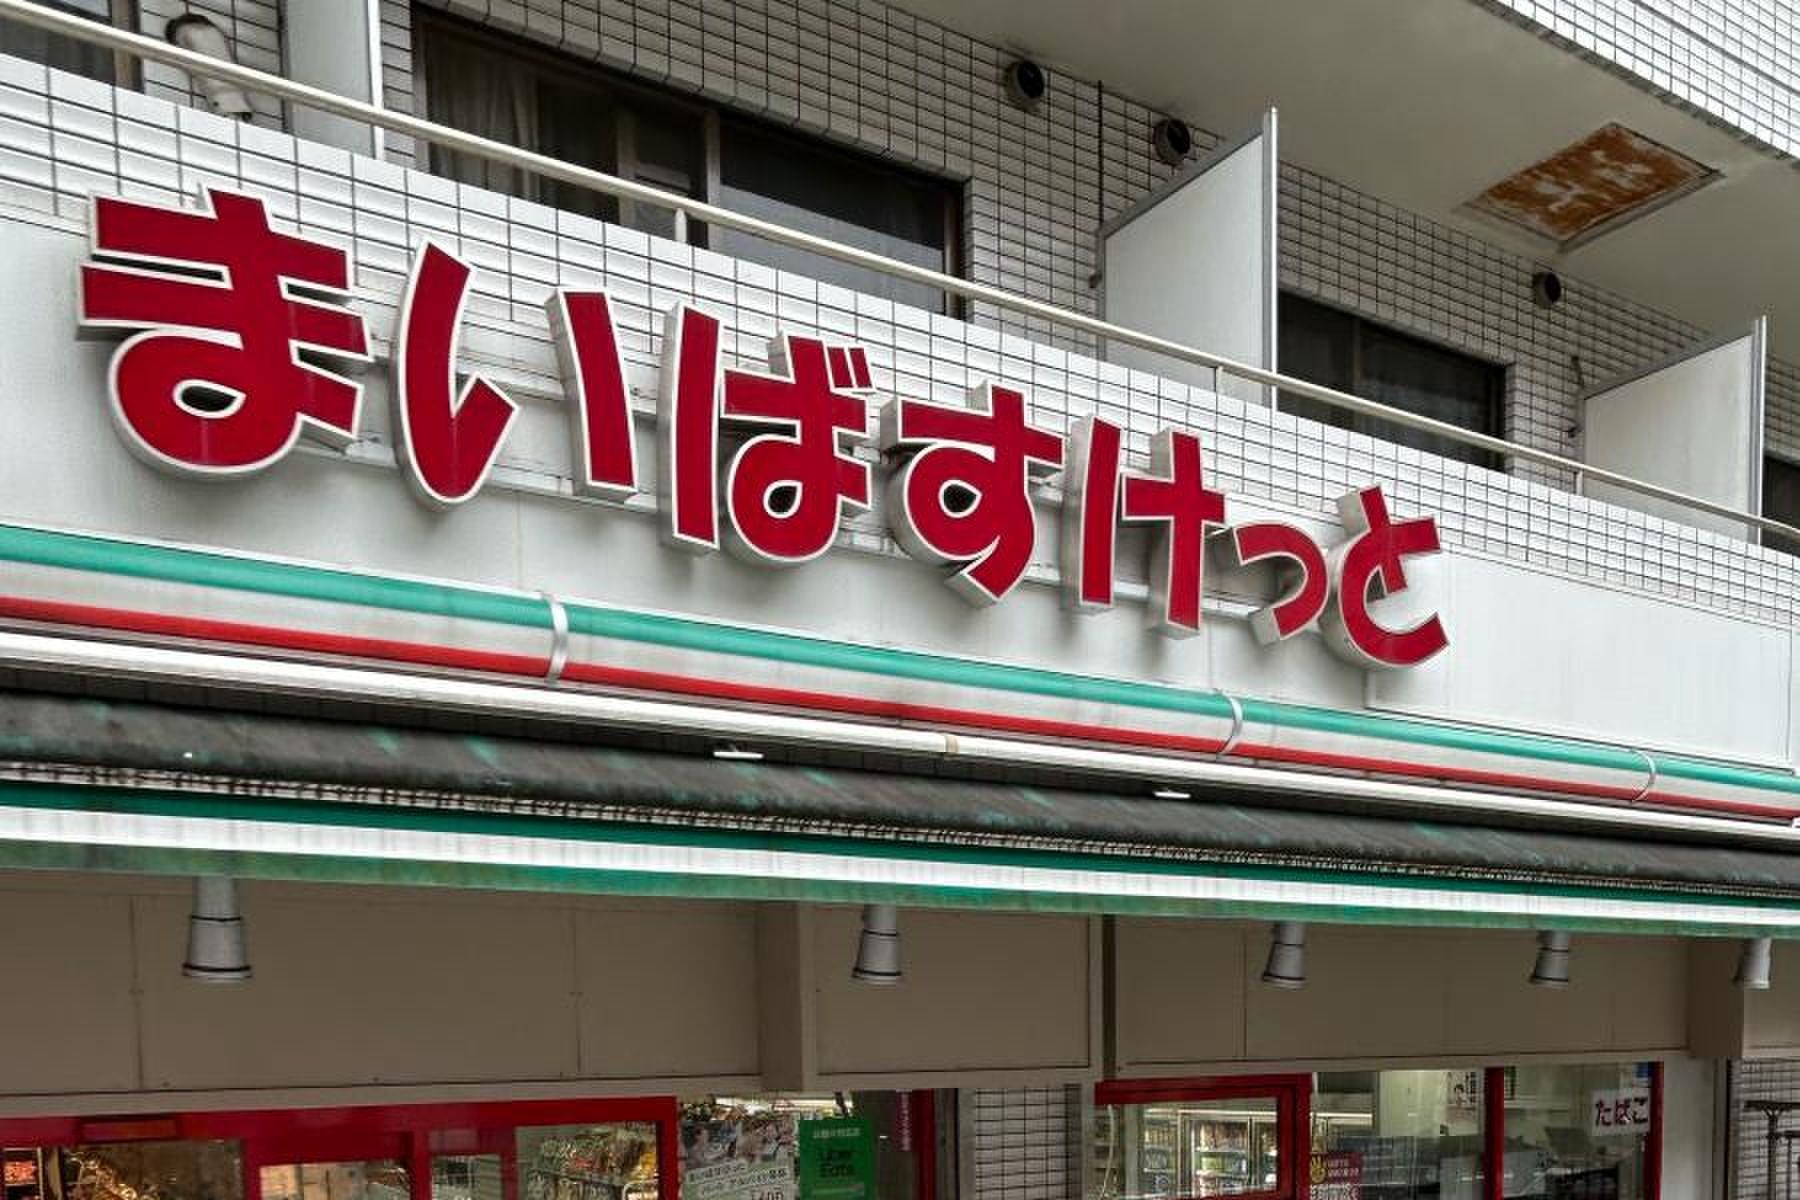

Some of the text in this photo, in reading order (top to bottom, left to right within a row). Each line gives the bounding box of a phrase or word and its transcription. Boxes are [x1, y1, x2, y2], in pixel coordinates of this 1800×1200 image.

[77, 188, 1447, 670] まいばすけっと
[1594, 1096, 1649, 1127] たばこ
